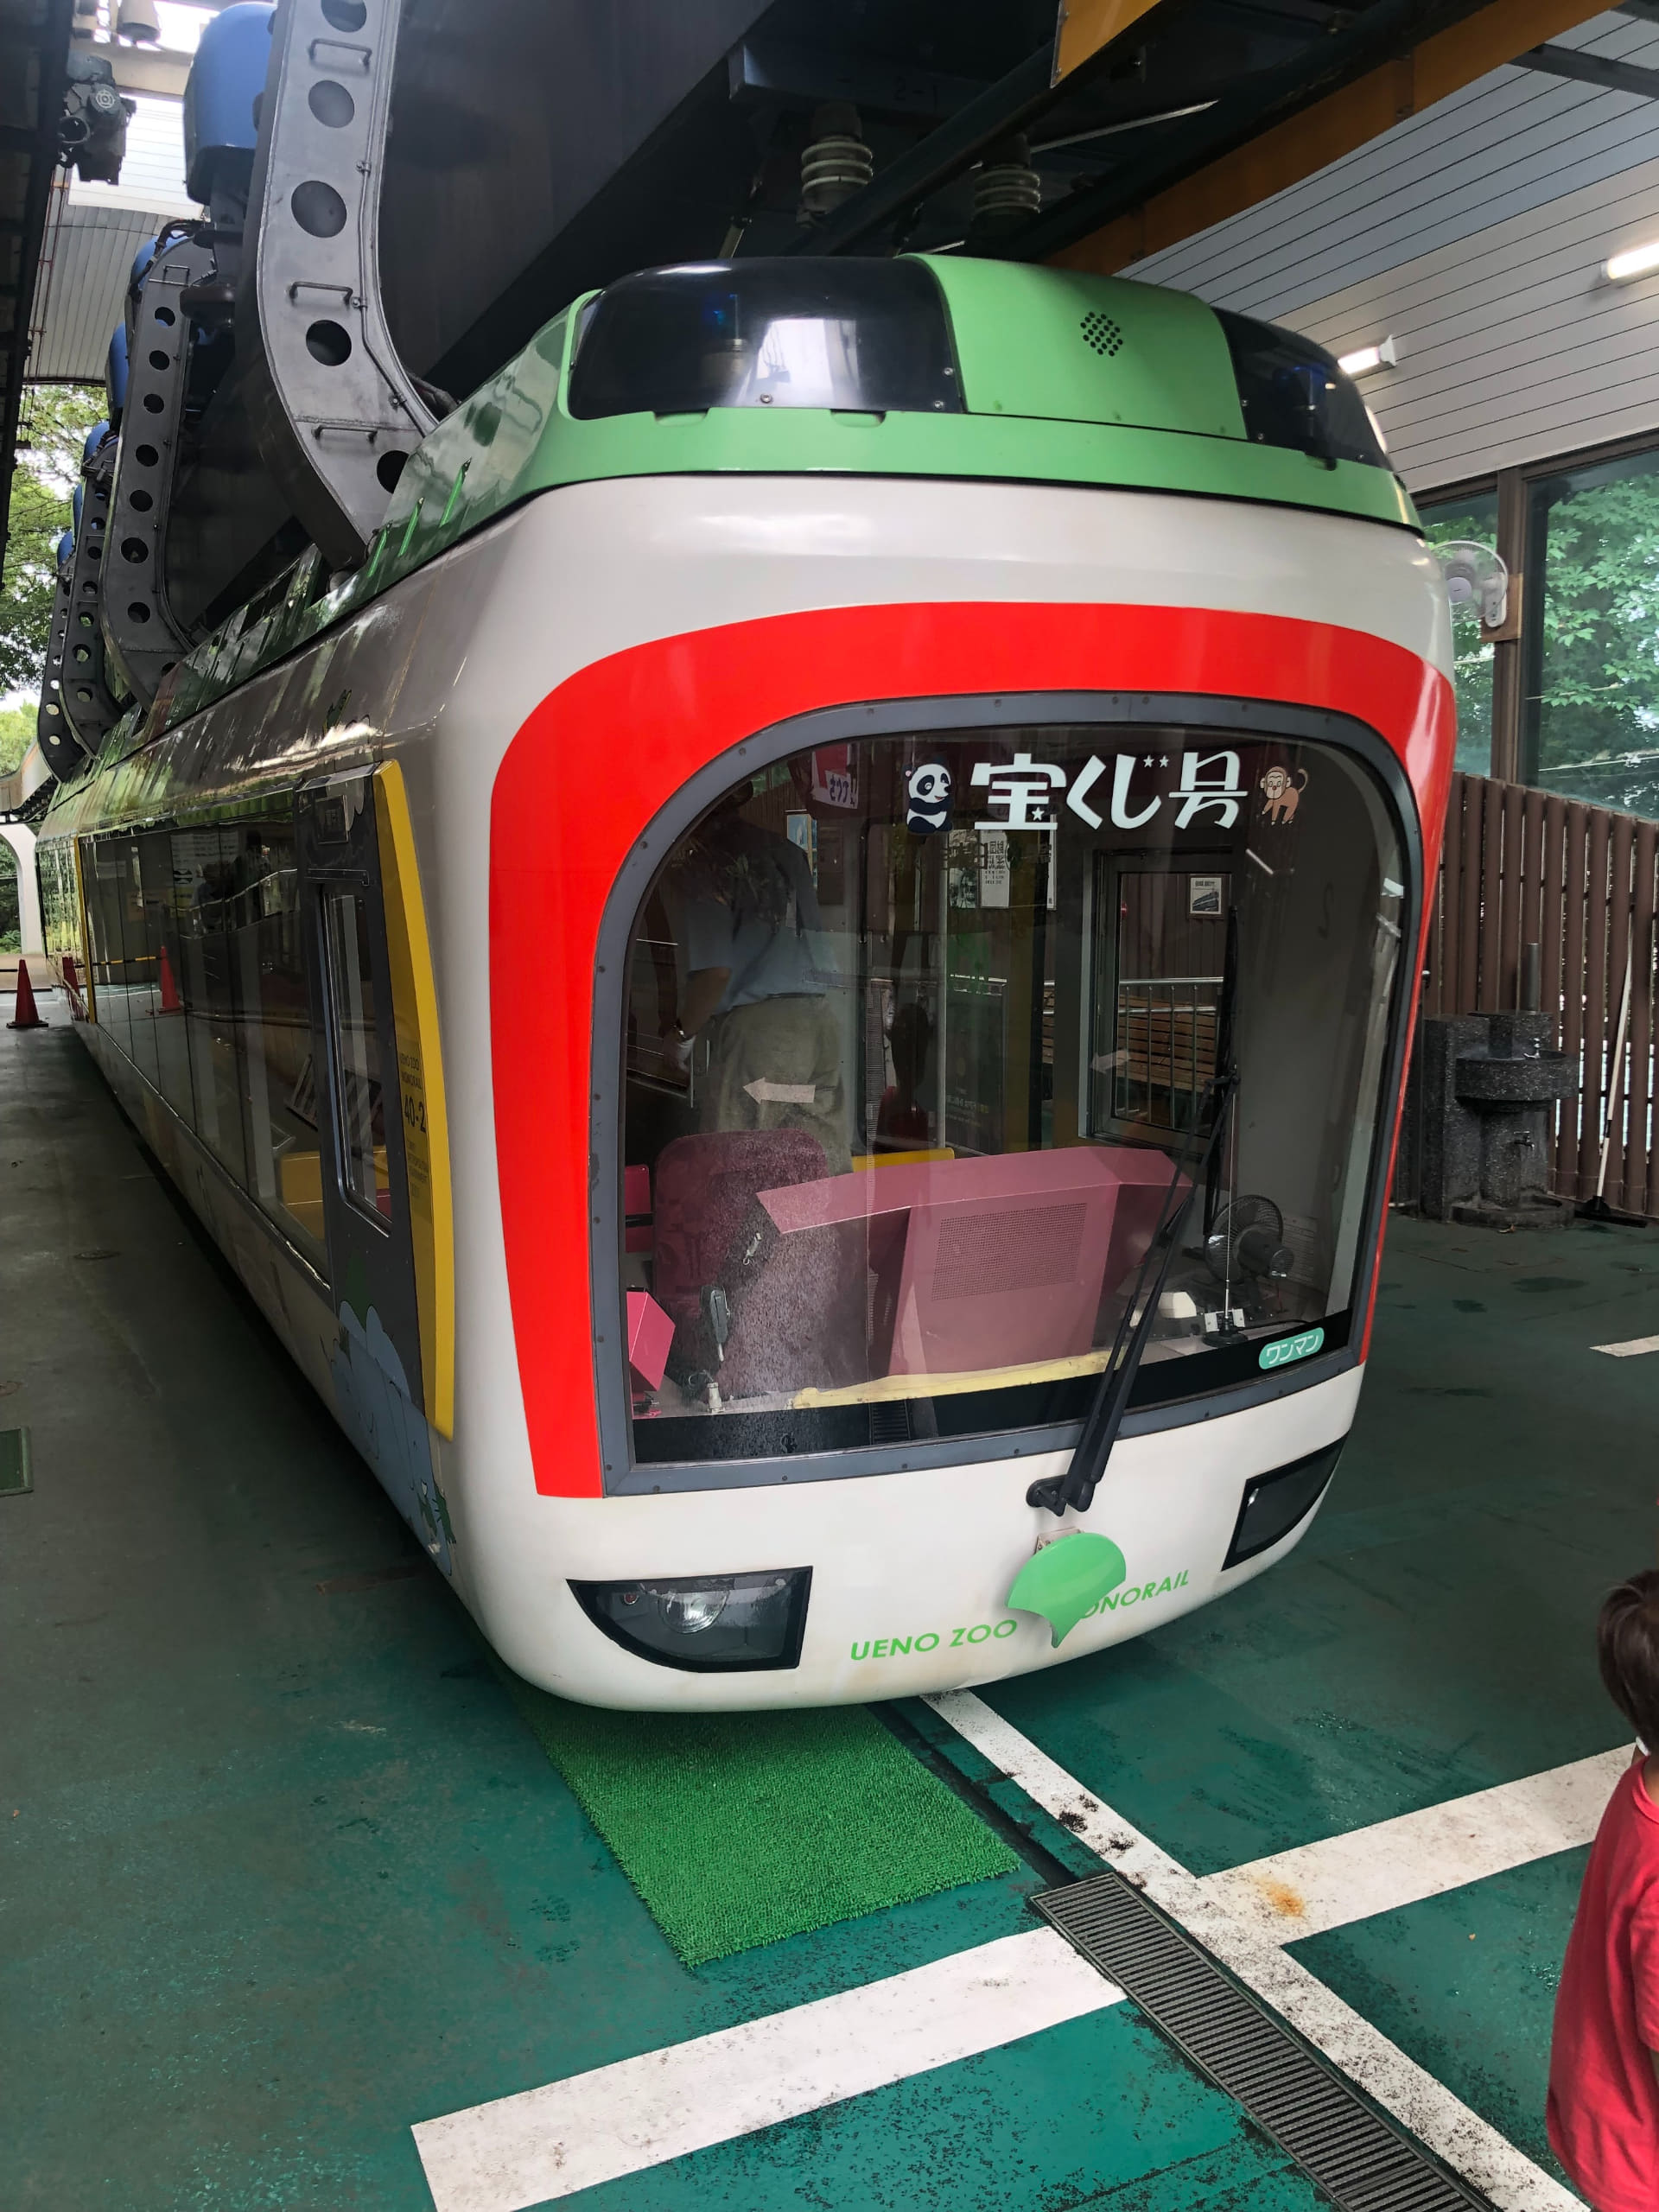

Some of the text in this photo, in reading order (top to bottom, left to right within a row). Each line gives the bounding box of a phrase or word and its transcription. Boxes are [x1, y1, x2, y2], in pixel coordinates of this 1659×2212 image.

[969, 750, 1249, 830] 宝くじ号
[1266, 1334, 1319, 1364] ワンマン
[850, 1632, 940, 1661] UENO
[949, 1618, 1018, 1648] ZOO
